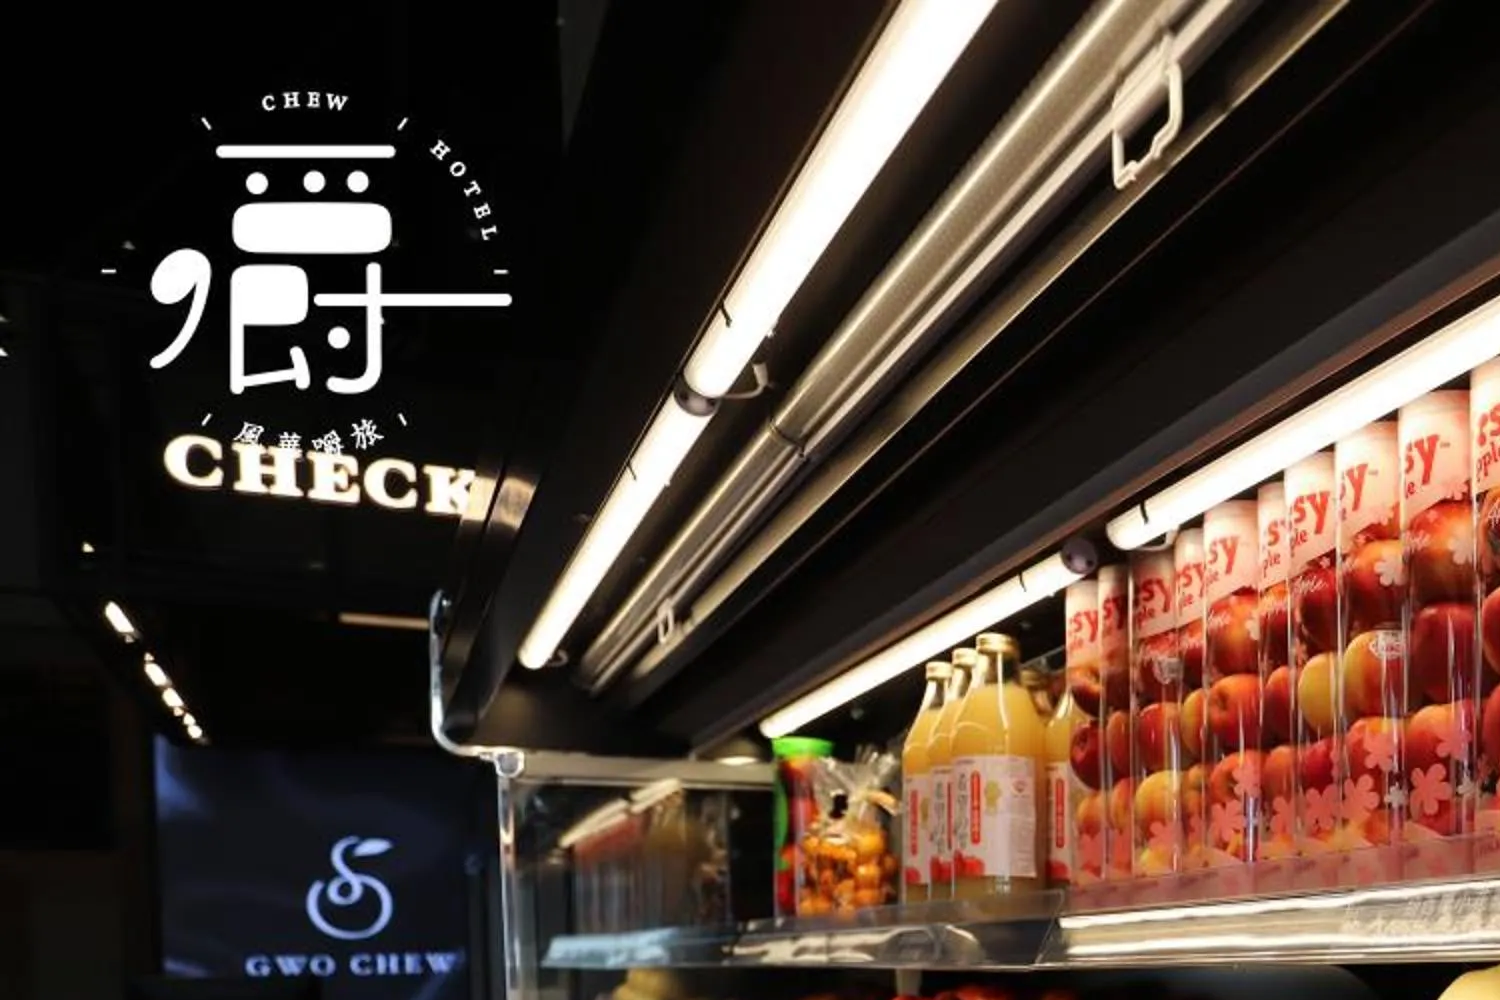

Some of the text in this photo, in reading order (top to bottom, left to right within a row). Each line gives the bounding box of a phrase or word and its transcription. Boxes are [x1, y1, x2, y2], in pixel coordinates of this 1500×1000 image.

[163, 434, 482, 518] CHECK
[1294, 490, 1331, 535] sy
[1208, 535, 1240, 575] sy
[1140, 577, 1171, 613] sy
[1071, 610, 1098, 642] sy
[245, 952, 459, 977] GWO CHEW
